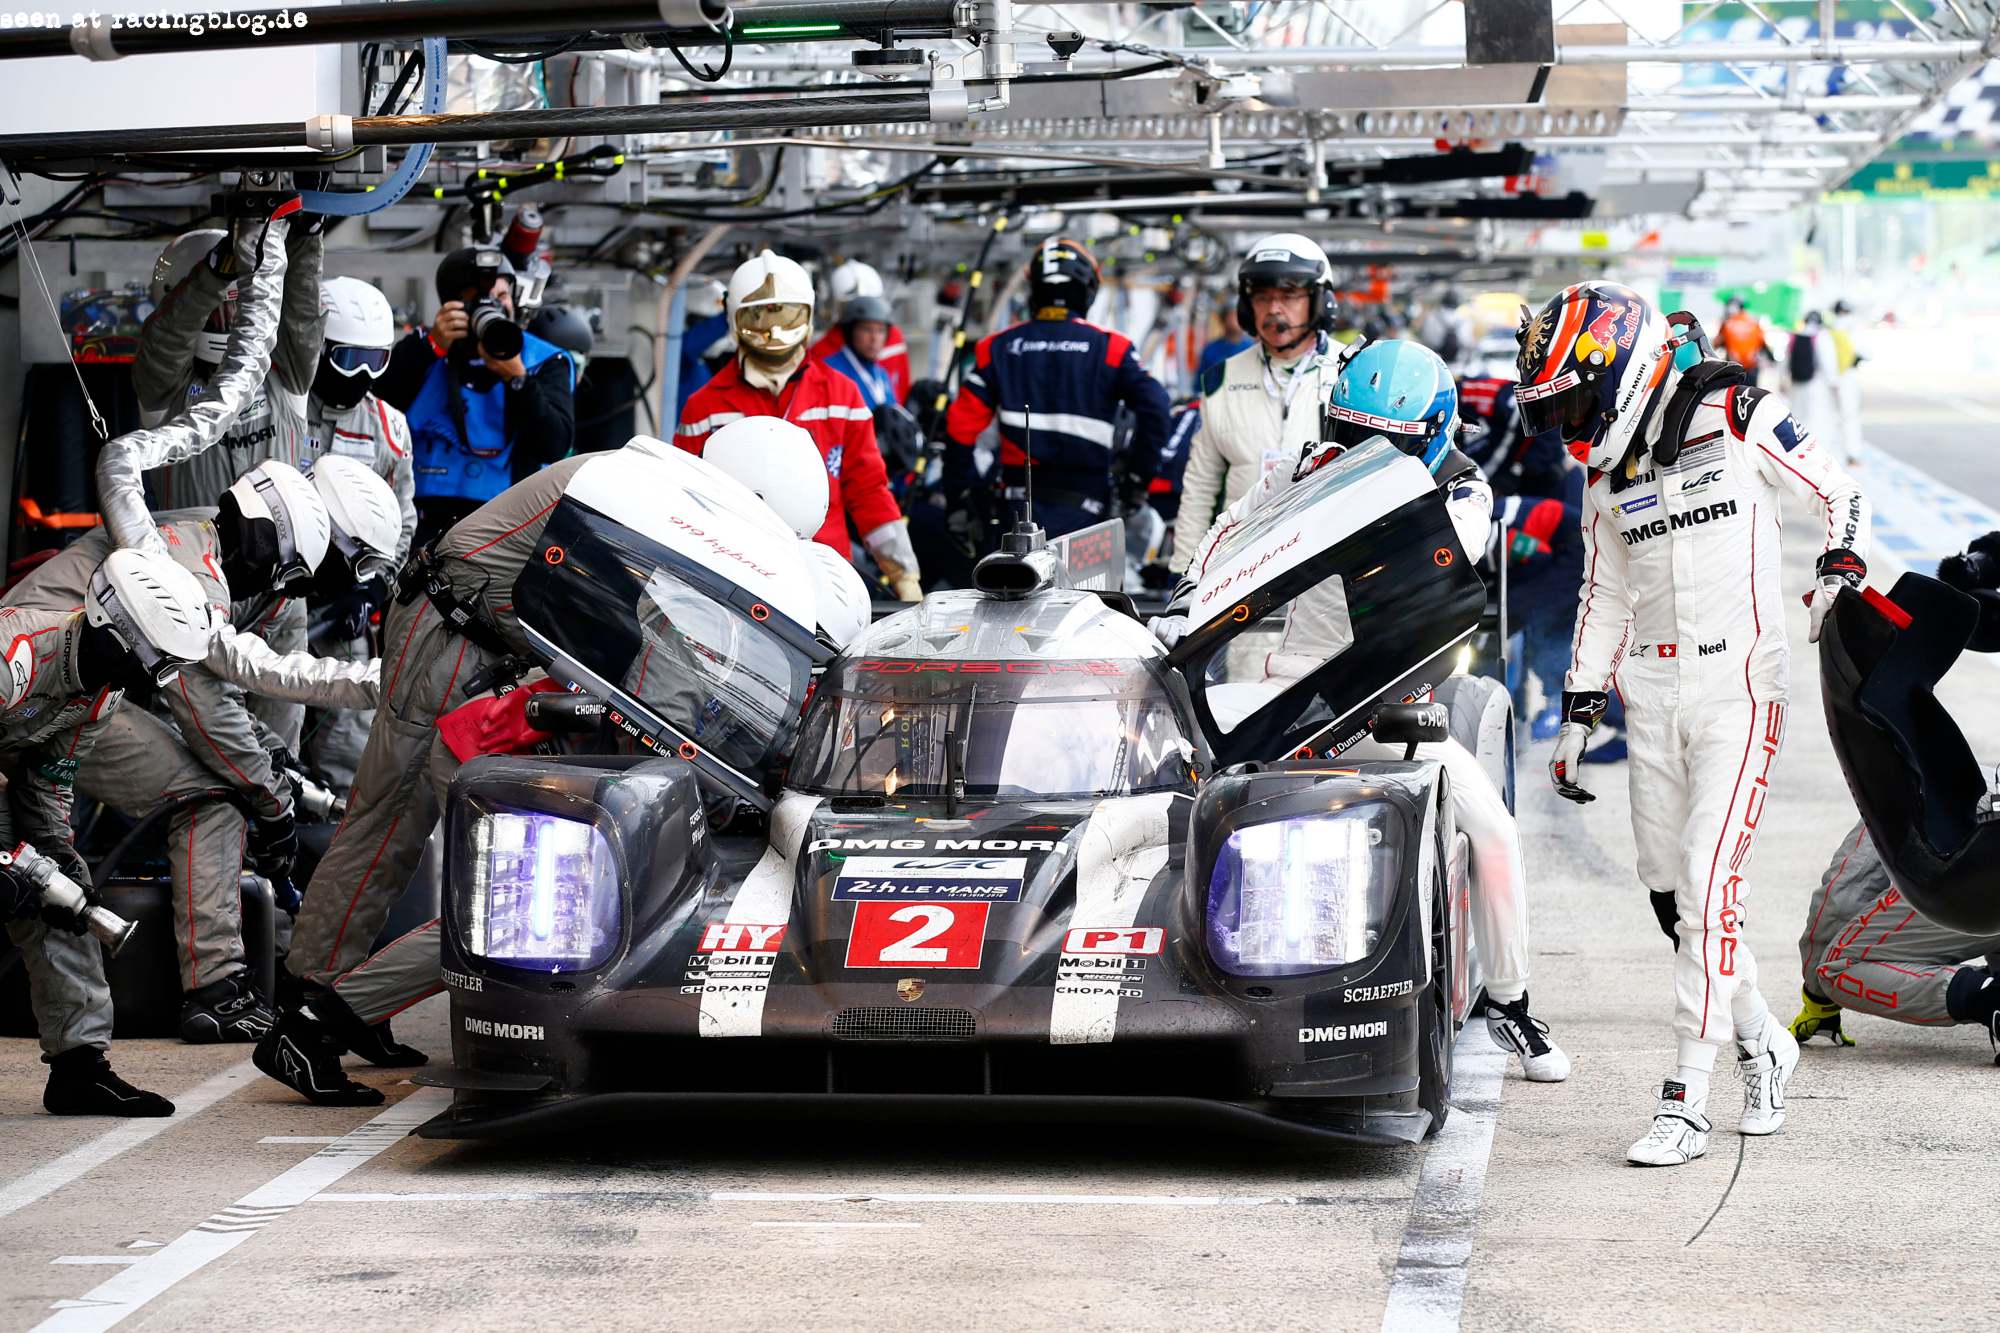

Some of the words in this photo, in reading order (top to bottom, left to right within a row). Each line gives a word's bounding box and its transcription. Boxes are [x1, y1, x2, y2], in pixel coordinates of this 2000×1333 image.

[1620, 388, 1636, 412] DMG
[1632, 363, 1647, 391] MORI
[1681, 469, 1724, 490] WEC
[271, 505, 288, 539] uvex
[1620, 519, 1667, 546] DMG
[1669, 500, 1738, 530] MORI
[1698, 639, 1727, 656] Neel
[63, 630, 71, 685] CHOPARD
[855, 659, 1127, 675] PORSCHE
[1412, 682, 1433, 699] Lieb
[620, 719, 641, 737] Jani
[1336, 728, 1367, 752] Dumas
[652, 741, 672, 758] Lieb
[808, 839, 927, 854] DMG
[935, 839, 1068, 852] MORI
[900, 885, 933, 894] LE
[936, 886, 1009, 894] MANS
[702, 924, 786, 950] HY
[879, 904, 955, 962] 2
[1083, 931, 1147, 949] P1
[689, 955, 752, 966] Mobil
[1060, 958, 1122, 968] Mobil
[1082, 973, 1142, 981] MICHELIN
[682, 985, 767, 994] CHOPARD
[1056, 987, 1141, 997] CHOPARD
[1343, 979, 1413, 1003] SCHAEFFLER
[465, 1016, 491, 1035] DMG
[494, 1022, 545, 1040] MORI
[1299, 1026, 1347, 1043] DMG
[1350, 1021, 1387, 1039] MORI
